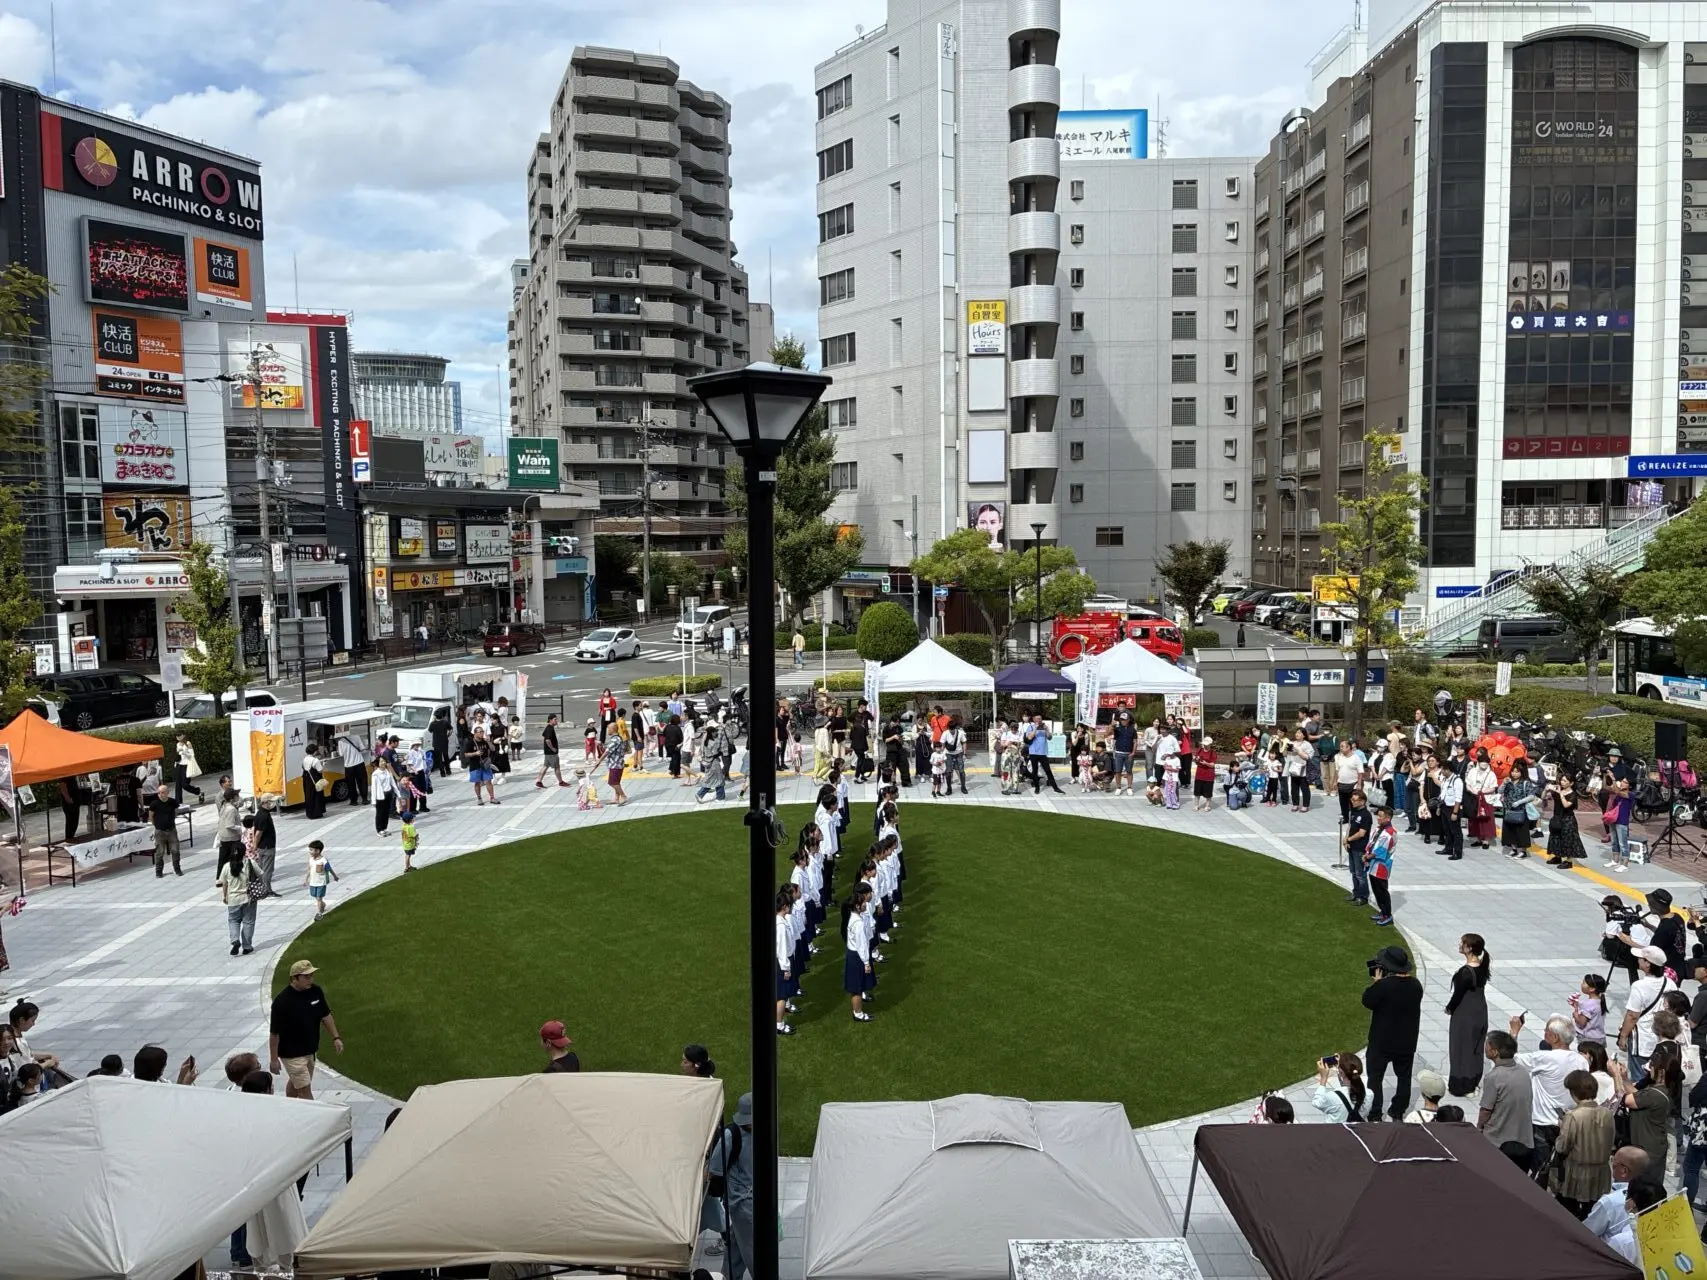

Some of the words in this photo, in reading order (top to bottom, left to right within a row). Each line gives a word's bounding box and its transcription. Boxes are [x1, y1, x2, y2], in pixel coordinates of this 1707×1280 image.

[1555, 121, 1595, 131] WORLD
[1056, 133, 1085, 141] 株式会社
[1090, 128, 1131, 142] マルキ
[132, 149, 260, 211] ARROW
[132, 186, 212, 218] PACHINKO
[215, 208, 225, 222] &
[228, 212, 261, 231] SLOT
[211, 251, 234, 269] 快活
[212, 267, 235, 280] CLUB
[972, 310, 1001, 320] 自習室
[1533, 315, 1608, 328] 買取大吉
[102, 322, 132, 341] 快活
[972, 324, 1001, 339] Hours
[104, 341, 133, 355] CLUB
[107, 381, 133, 391] コミック
[144, 384, 182, 396] インターネット
[330, 369, 339, 414] EXCITING
[122, 444, 167, 457] カラオケ
[333, 419, 342, 470] PACHINKO
[1529, 441, 1583, 452] アコム
[518, 454, 550, 466] Wam
[1648, 462, 1688, 470] REALIZE
[115, 459, 177, 480] まねきねこ
[354, 461, 369, 479] P
[335, 482, 344, 508] SLOT
[158, 576, 190, 585] ARRO
[1313, 671, 1342, 681] 分煙所
[264, 719, 274, 785] クラフトビール
